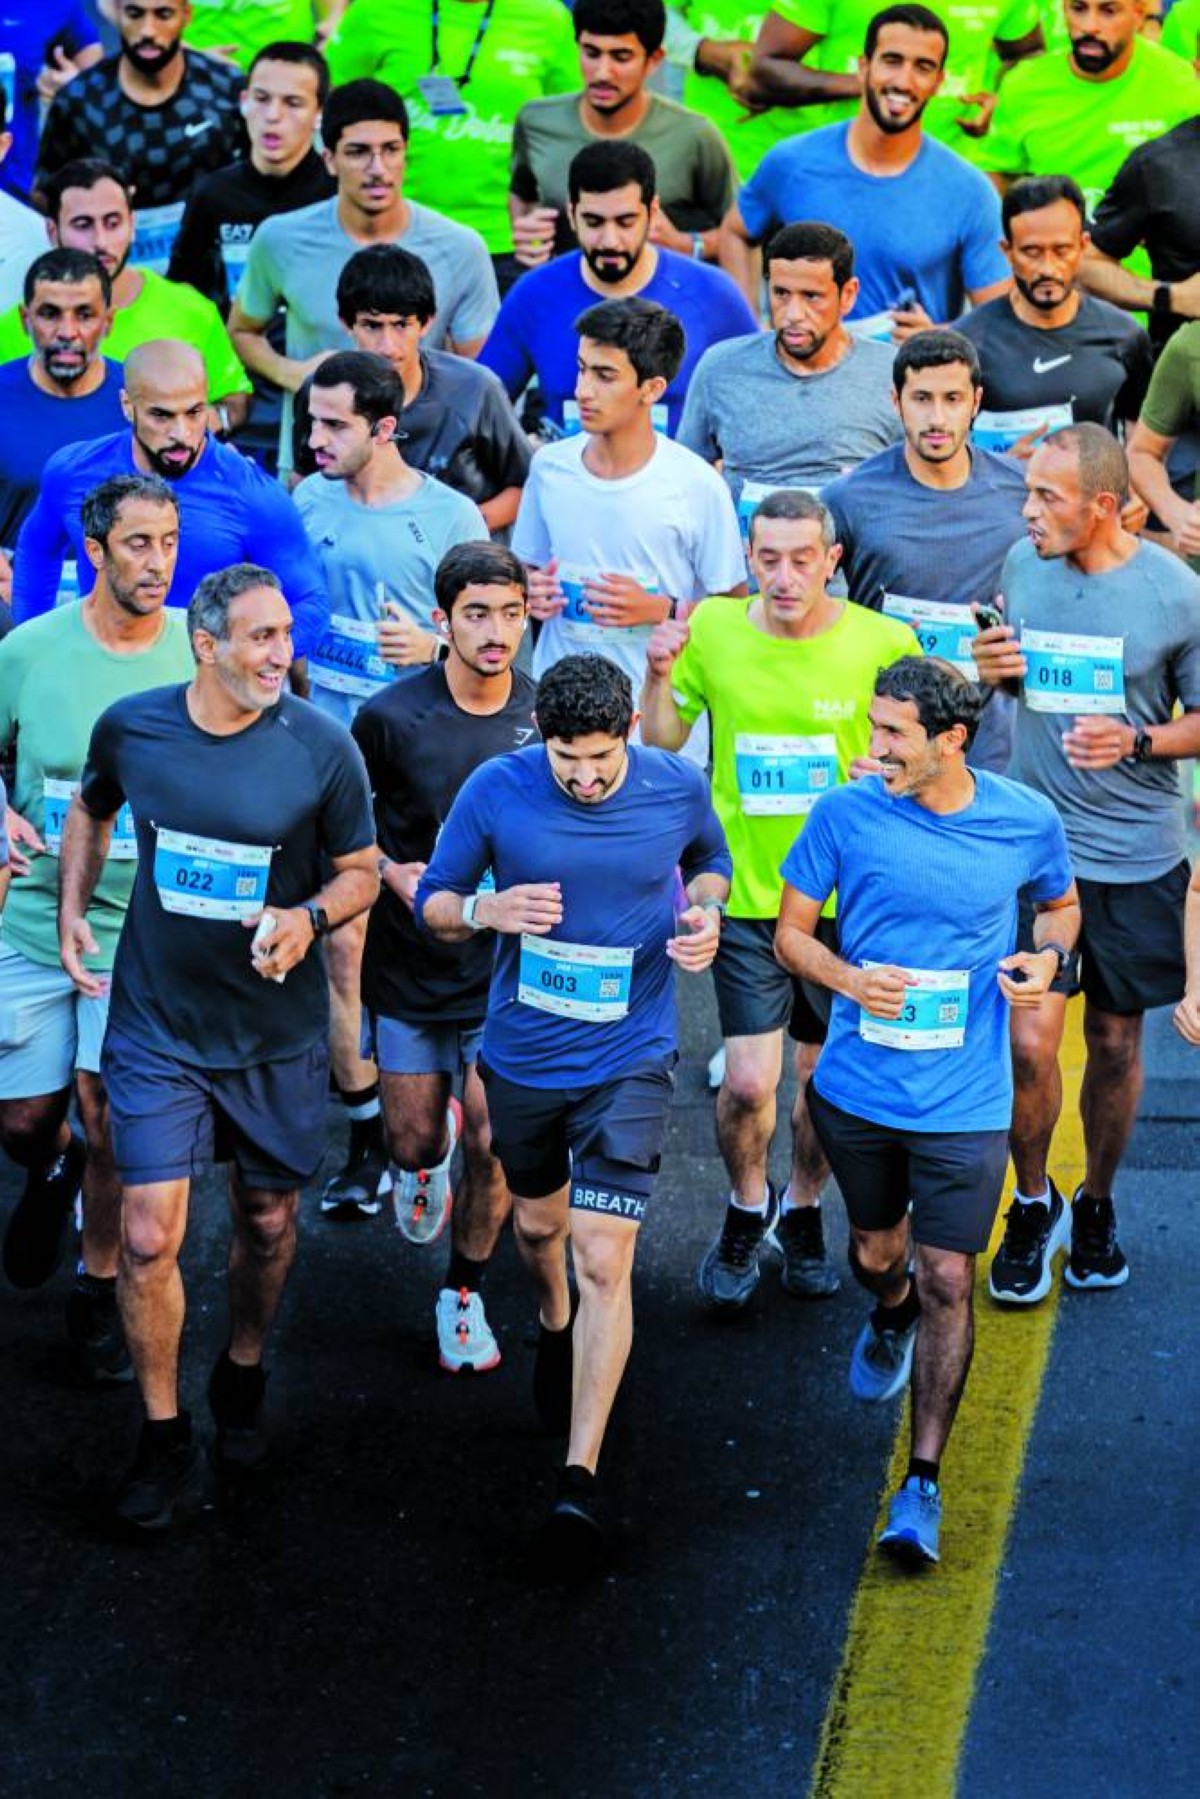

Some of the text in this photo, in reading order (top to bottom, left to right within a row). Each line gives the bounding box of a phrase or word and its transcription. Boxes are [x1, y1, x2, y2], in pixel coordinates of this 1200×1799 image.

[1039, 666, 1073, 687] 018
[752, 768, 786, 789] 011
[176, 868, 215, 892] 022
[541, 970, 577, 993] 003
